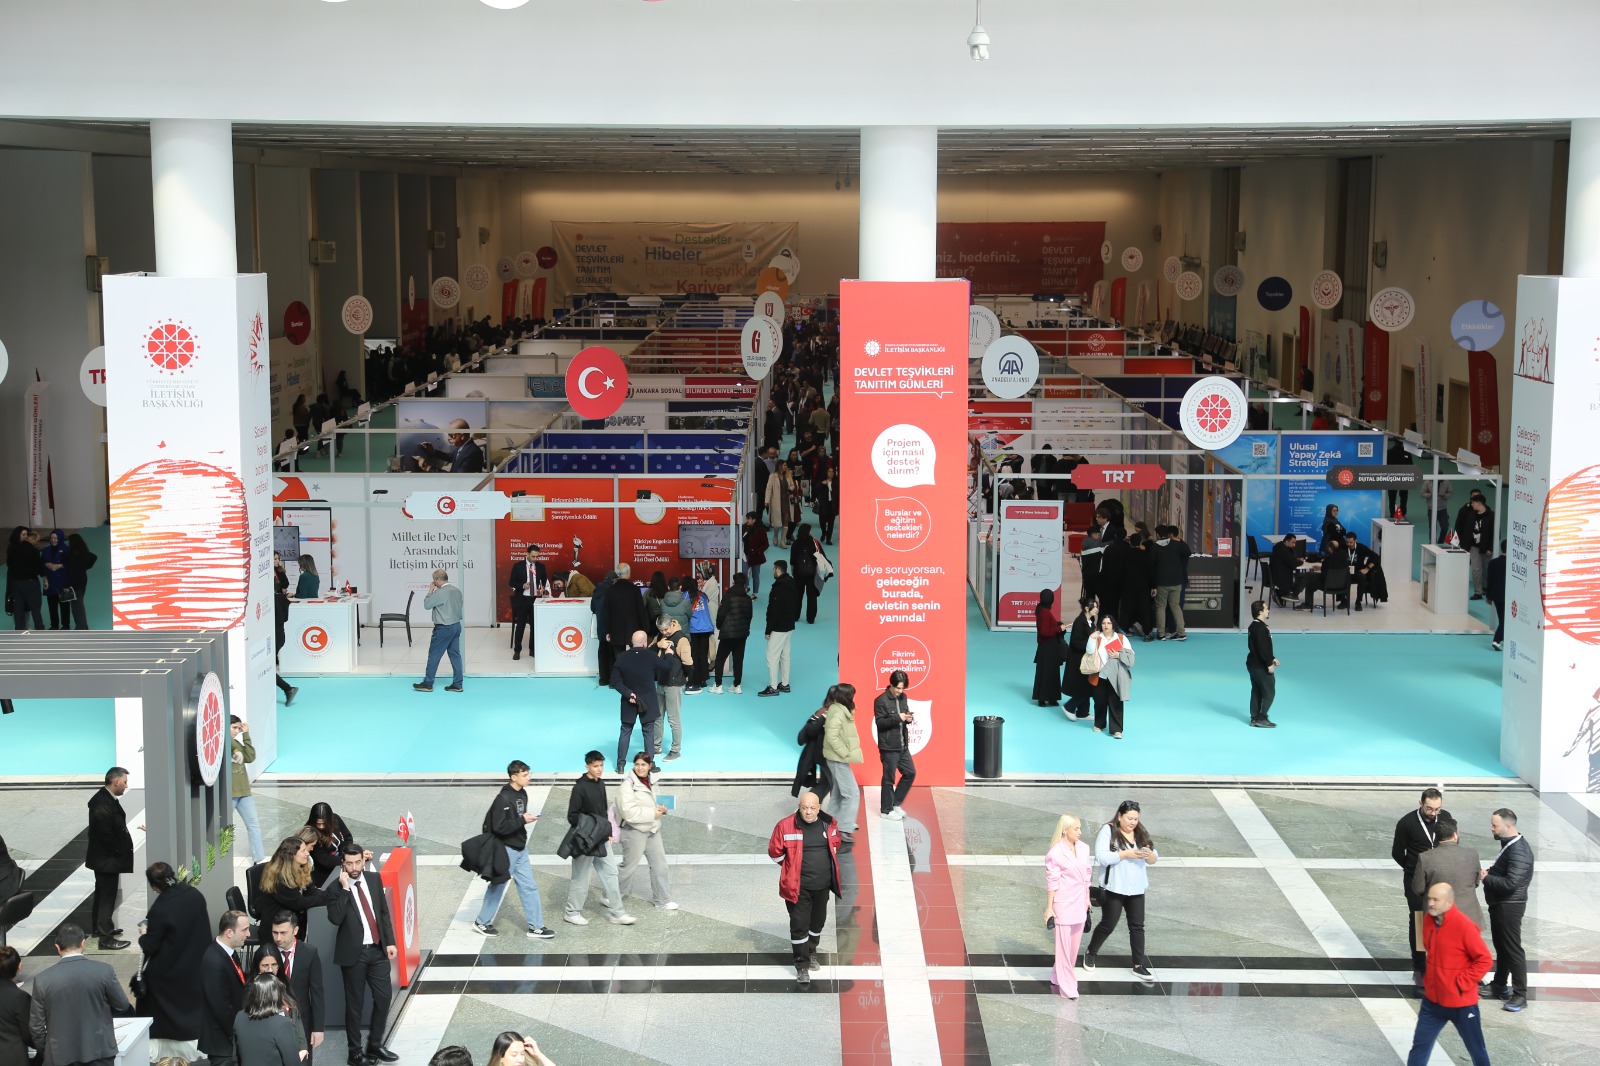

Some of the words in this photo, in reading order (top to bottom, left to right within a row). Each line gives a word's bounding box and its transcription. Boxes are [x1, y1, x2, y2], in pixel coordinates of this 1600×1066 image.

[676, 233, 732, 245] Destekler
[576, 245, 607, 253] DEVLET
[644, 246, 702, 260] Hibeler
[1042, 246, 1075, 255] DEVLET
[576, 254, 624, 264] TEŞVİKLERİ
[959, 251, 1020, 264] hedefiniz,
[1042, 256, 1091, 266] TEŞVİKLERİ
[576, 266, 611, 274] TANITIM
[949, 266, 975, 277] var?
[1042, 267, 1077, 275] TANITIM
[854, 367, 893, 376] DEVLET
[896, 365, 954, 378] TEŞVİKLERİ
[1000, 360, 1021, 374] AA
[855, 380, 896, 389] TANITIM
[899, 378, 944, 389] GÜNLERİ
[150, 389, 195, 399] İLETİŞİM
[142, 399, 203, 409] BAŞKANLIĞI
[1516, 426, 1541, 446] Geleceğin
[887, 438, 921, 448] Projem
[1289, 442, 1318, 451] Ulusal
[1516, 440, 1533, 456] burada
[882, 448, 900, 458] için
[902, 448, 924, 456] nasıl
[1289, 451, 1317, 460] Yapay
[887, 457, 920, 465] destek
[1289, 459, 1329, 468] Stratejisi
[1515, 456, 1535, 473] devletin
[888, 466, 920, 475] alırım?
[1102, 470, 1135, 483] TRT
[1515, 474, 1528, 486] senin
[890, 517, 915, 525] eğitim
[1512, 521, 1527, 534] DEVLET
[392, 532, 421, 541] Millet
[424, 532, 435, 541] ile
[438, 532, 470, 541] Devet
[686, 541, 696, 554] 3.
[710, 547, 730, 555] 53.89
[1512, 534, 1534, 552] TEŞVİKLERİ
[404, 546, 459, 555] Arasındaki
[1512, 548, 1527, 562] TANITIM
[389, 558, 428, 571] İletişim
[860, 564, 882, 576] diye
[885, 566, 945, 576] soruyorsan,
[1512, 562, 1527, 577] GÜNLERİ
[876, 576, 929, 588] geleceğin
[882, 589, 923, 600] burada,
[865, 601, 909, 610] devletin
[912, 600, 940, 610] senin
[879, 612, 926, 624] yanında!
